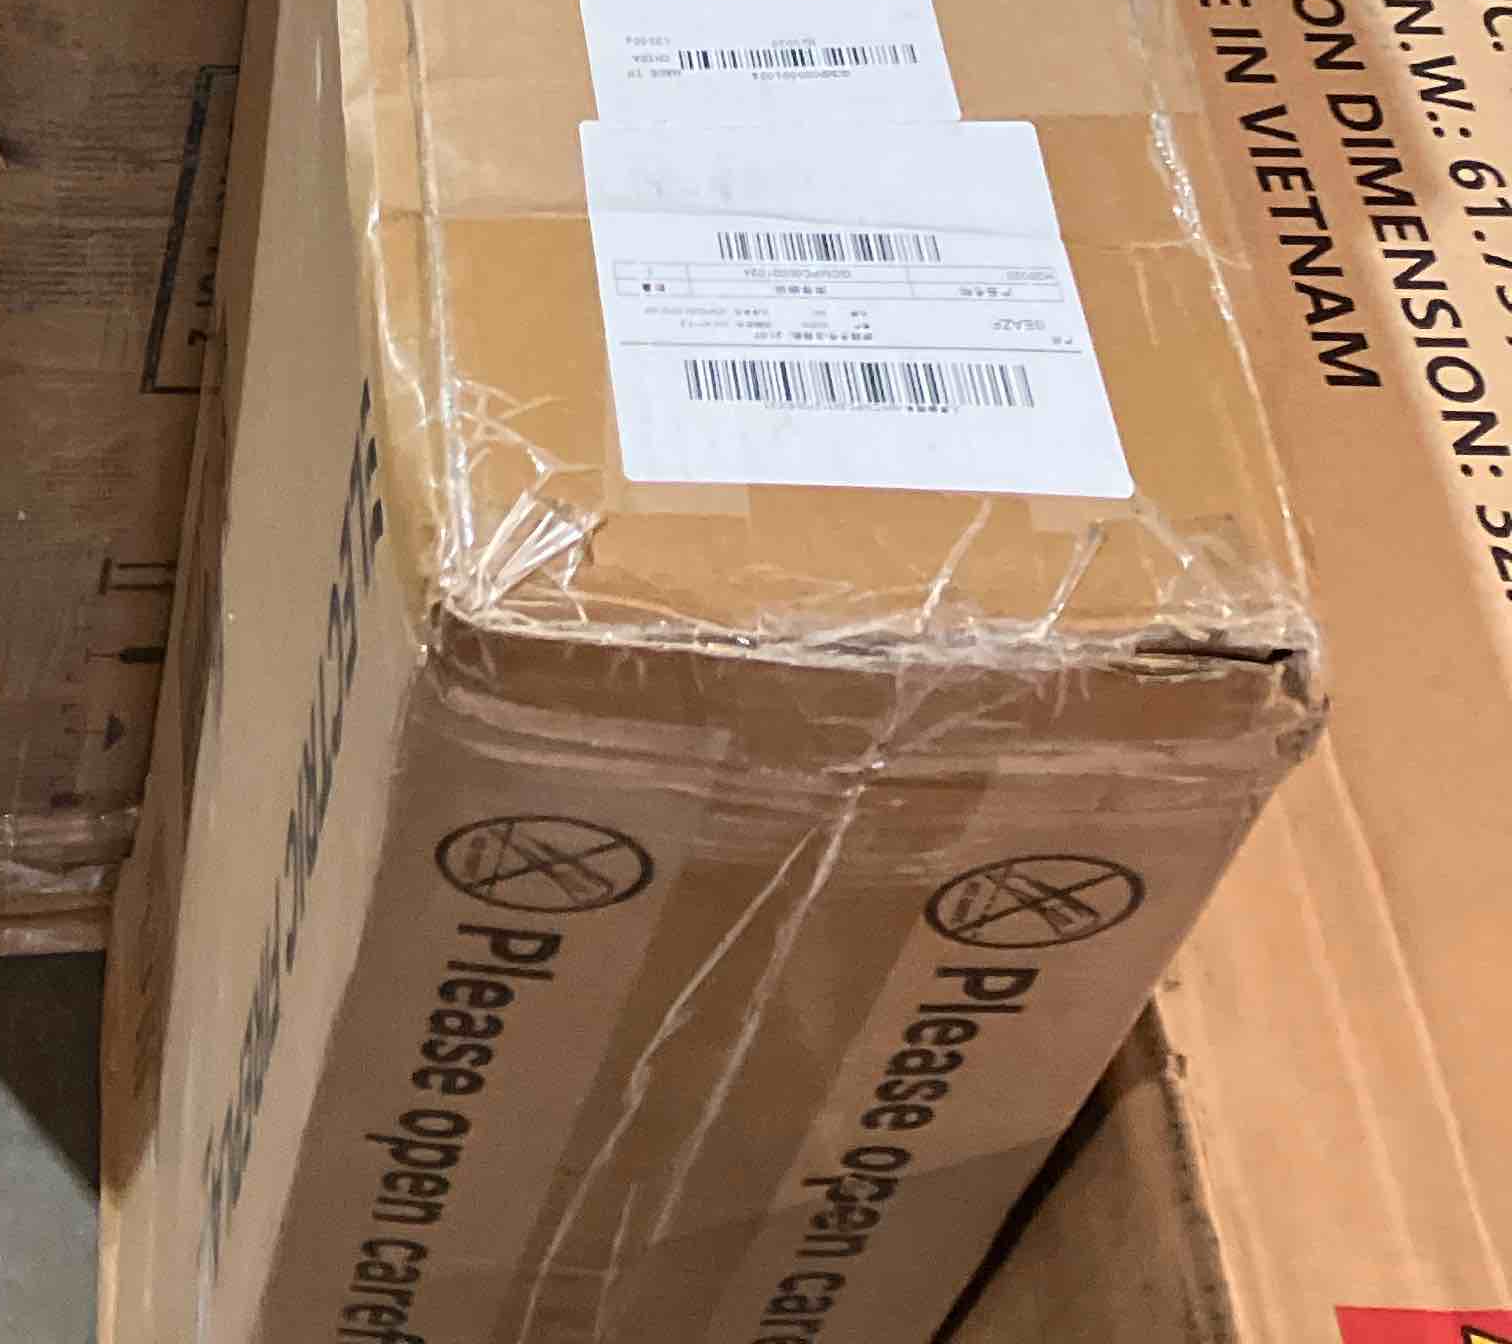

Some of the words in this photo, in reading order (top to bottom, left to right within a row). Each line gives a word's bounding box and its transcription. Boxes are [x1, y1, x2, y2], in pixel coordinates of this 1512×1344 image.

[1209, 27, 1278, 84] IN
[1239, 104, 1384, 388] VIETNAM
[1326, 94, 1512, 477] DIMENSION:
[410, 922, 564, 1098] Please
[862, 967, 1041, 1133] Please
[364, 1108, 473, 1226] open
[795, 1145, 914, 1260] open
